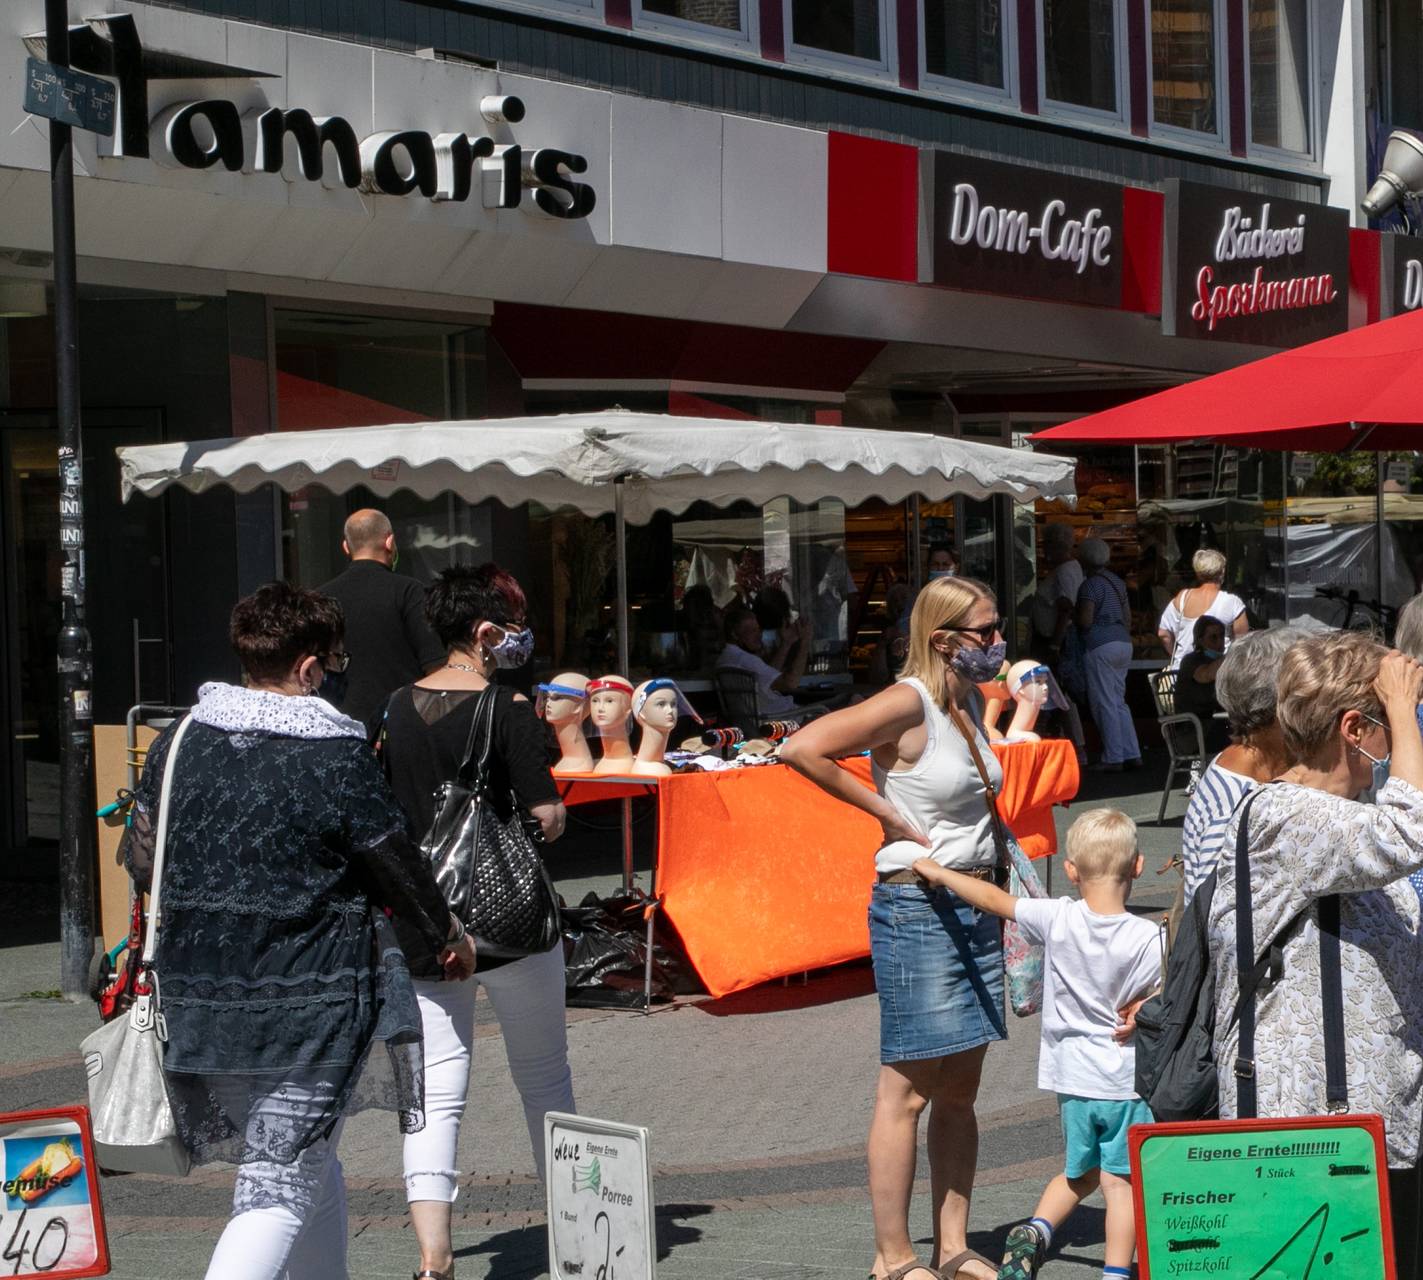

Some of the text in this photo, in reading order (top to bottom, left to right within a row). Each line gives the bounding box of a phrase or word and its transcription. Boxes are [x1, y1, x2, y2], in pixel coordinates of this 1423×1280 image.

[22, 12, 595, 219] Tamaris
[950, 183, 1112, 274] Dom-Cafe
[1215, 203, 1306, 262] Bäckerei
[1191, 265, 1338, 331] Sporkmann
[586, 1142, 603, 1154] Eigene
[604, 1145, 618, 1157] Ernte
[1187, 1146, 1242, 1161] Eigene
[1255, 1166, 1296, 1178] 1 Stück
[0, 1175, 73, 1195] emüse
[602, 1187, 633, 1206] Porree
[1162, 1190, 1236, 1205] Frischer
[565, 1211, 578, 1222] Bund
[1165, 1214, 1229, 1233] Weißkohl
[1167, 1256, 1232, 1274] Spitzkohl
